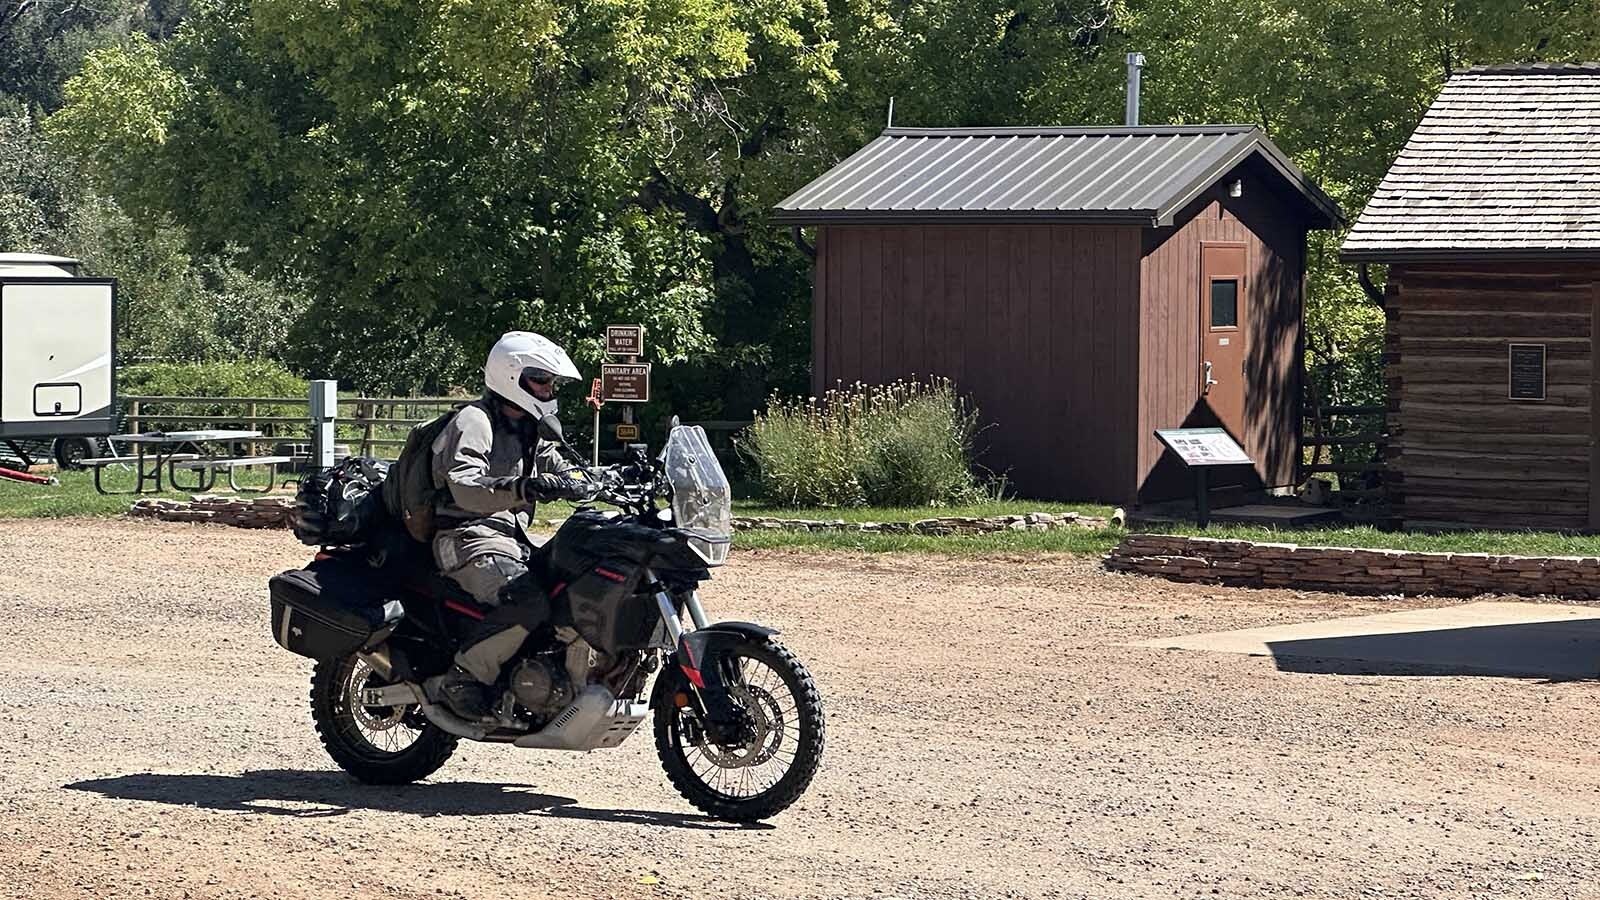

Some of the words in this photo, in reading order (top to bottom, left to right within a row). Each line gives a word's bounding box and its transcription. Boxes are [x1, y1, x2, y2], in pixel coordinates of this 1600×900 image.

[610, 329, 637, 337] DRINKING
[615, 338, 633, 346] WATER
[604, 367, 631, 375] SANITARY
[632, 367, 646, 375] AREA
